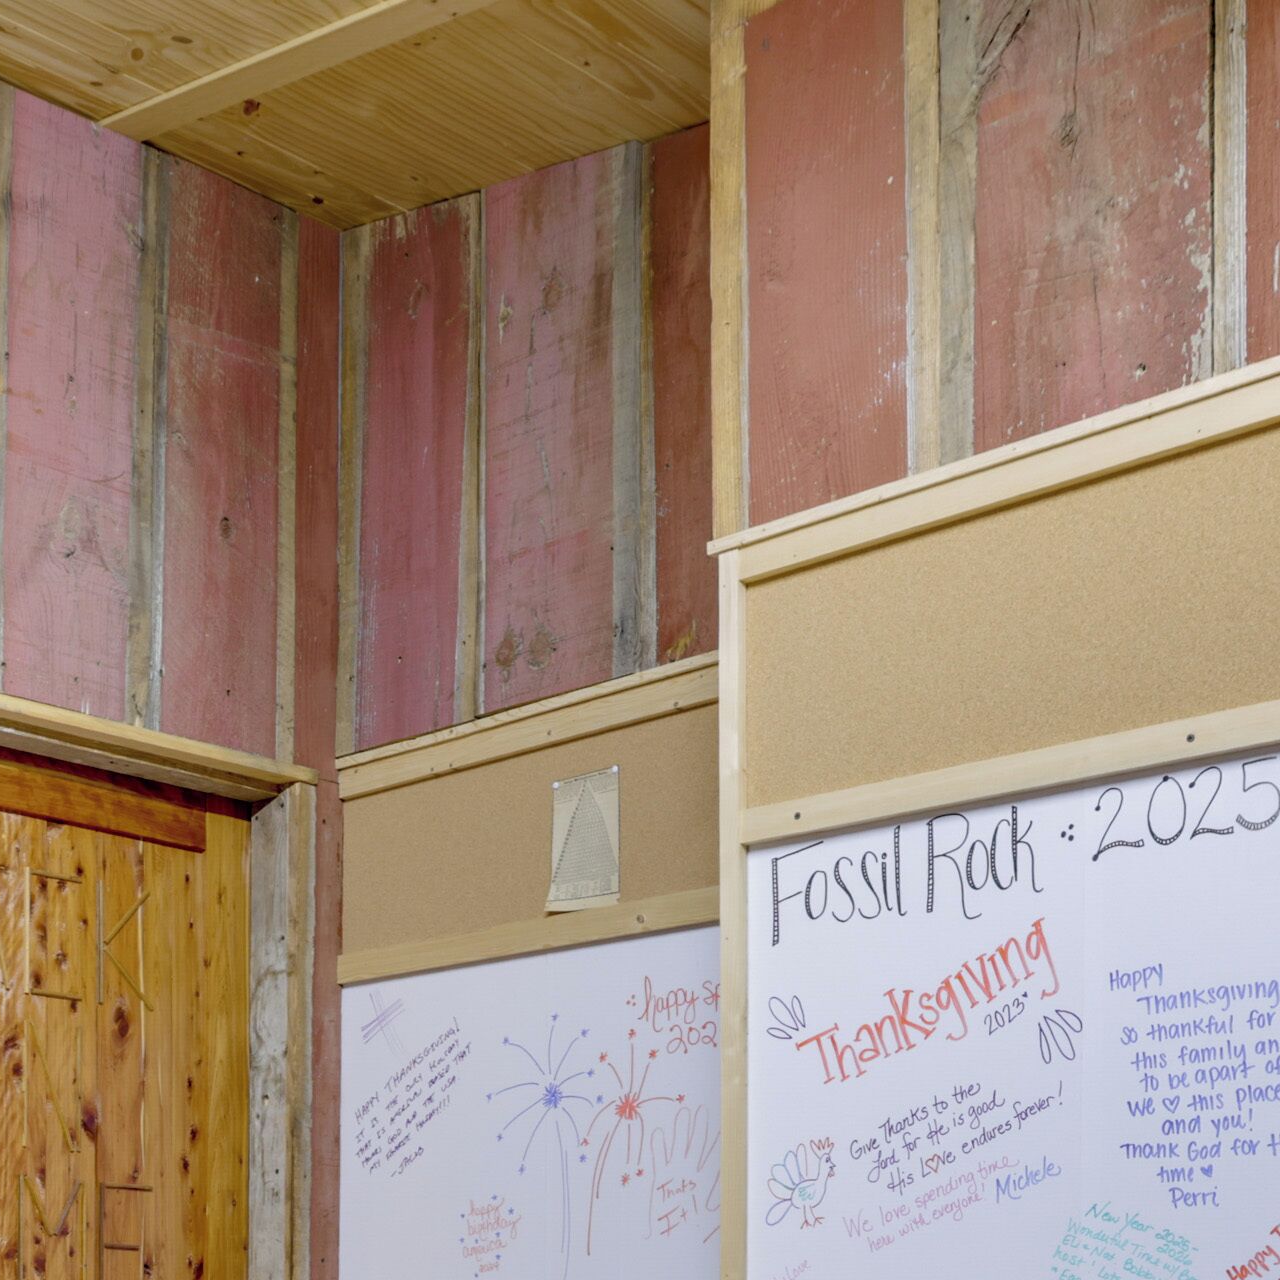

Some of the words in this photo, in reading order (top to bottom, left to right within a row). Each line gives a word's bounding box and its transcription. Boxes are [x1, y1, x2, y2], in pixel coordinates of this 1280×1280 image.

[771, 824, 908, 947] Fossil
[926, 805, 1044, 920] Rock
[1108, 963, 1163, 992] Happy
[983, 996, 1026, 1036] 2023
[1146, 1014, 1234, 1042] thankful
[1245, 1009, 1276, 1031] for
[665, 1020, 720, 1055] 202
[1130, 1051, 1168, 1072] this
[1177, 1039, 1247, 1066] family
[1139, 1072, 1160, 1092] to
[1168, 1071, 1190, 1091] be
[960, 1120, 1013, 1155] endures
[1012, 1079, 1064, 1131] forever!
[1186, 1092, 1224, 1112] this
[849, 1139, 880, 1161] Give
[878, 1104, 929, 1143] Thanks
[932, 1094, 949, 1115] to
[952, 1082, 981, 1104] the
[902, 1133, 921, 1161] for
[952, 1111, 966, 1128] is
[966, 1089, 1006, 1125] good
[1160, 1115, 1202, 1136] and
[1210, 1108, 1254, 1138] you!
[1186, 1140, 1222, 1162] God
[1229, 1138, 1261, 1157] for
[993, 1155, 1062, 1205] Michele
[841, 1208, 874, 1239] We
[878, 1202, 912, 1227] love
[913, 1170, 978, 1210] spending
[1168, 1186, 1220, 1209] Perri
